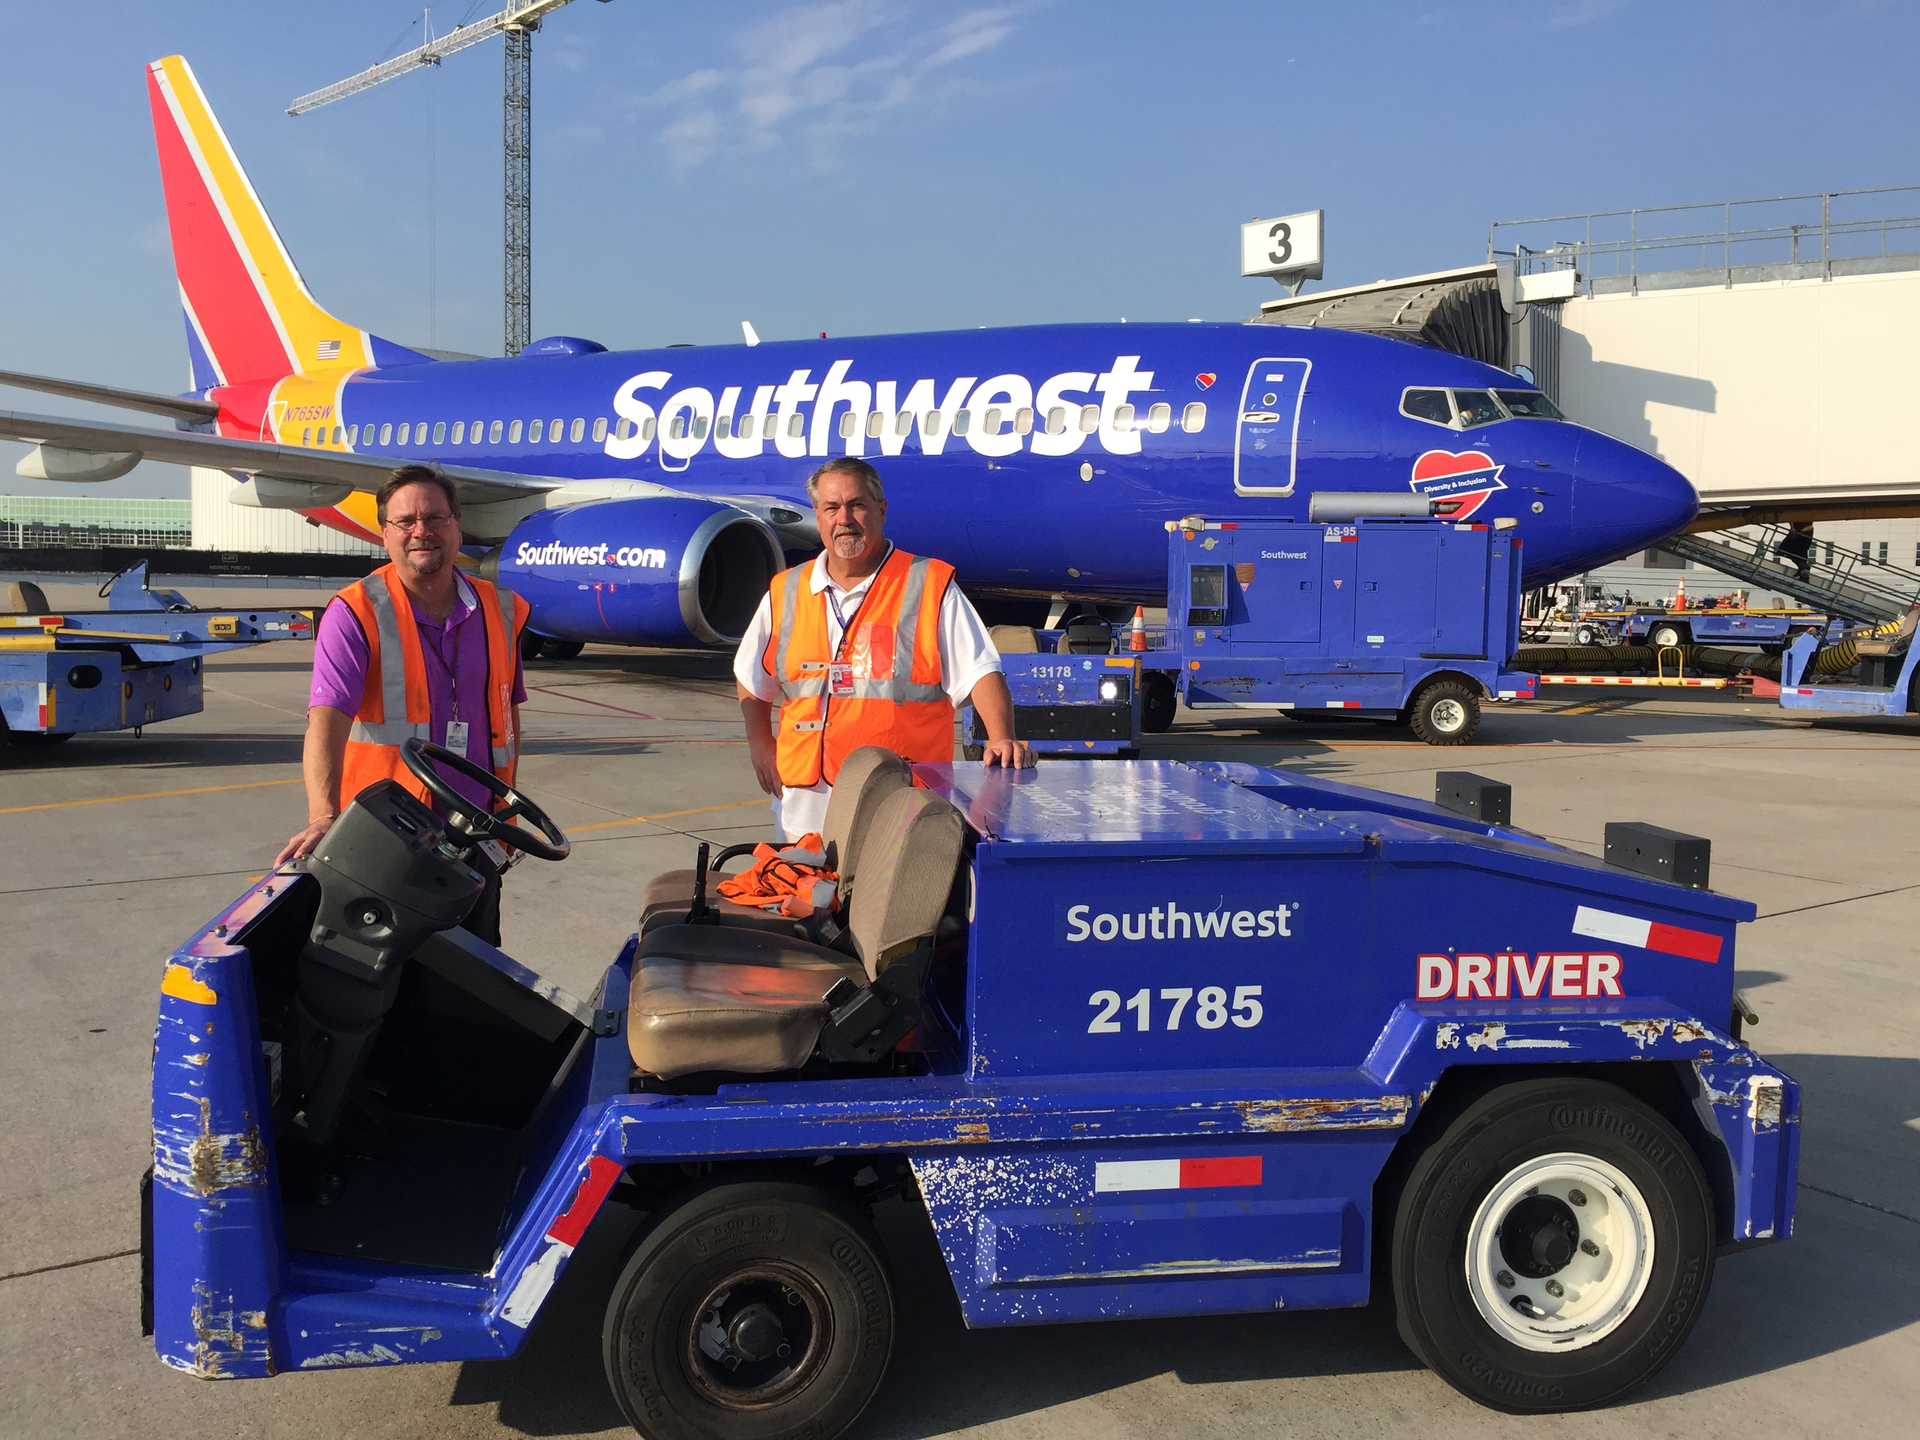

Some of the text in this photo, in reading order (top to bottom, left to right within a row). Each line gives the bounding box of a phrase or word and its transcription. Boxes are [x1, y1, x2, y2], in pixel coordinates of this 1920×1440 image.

[1267, 222, 1293, 265] 3
[283, 404, 335, 423] N765SW
[604, 355, 1155, 459] Southwest
[1424, 484, 1451, 493] Diversity
[1458, 477, 1487, 488] Inclusion
[1325, 526, 1357, 536] AS-95
[1260, 550, 1308, 559] Southwest
[1031, 665, 1071, 678] 13178
[1066, 901, 1291, 942] Southwest
[1416, 952, 1625, 1001] DRIVER
[1087, 985, 1264, 1034] 21785
[1549, 1103, 1677, 1171] Continental
